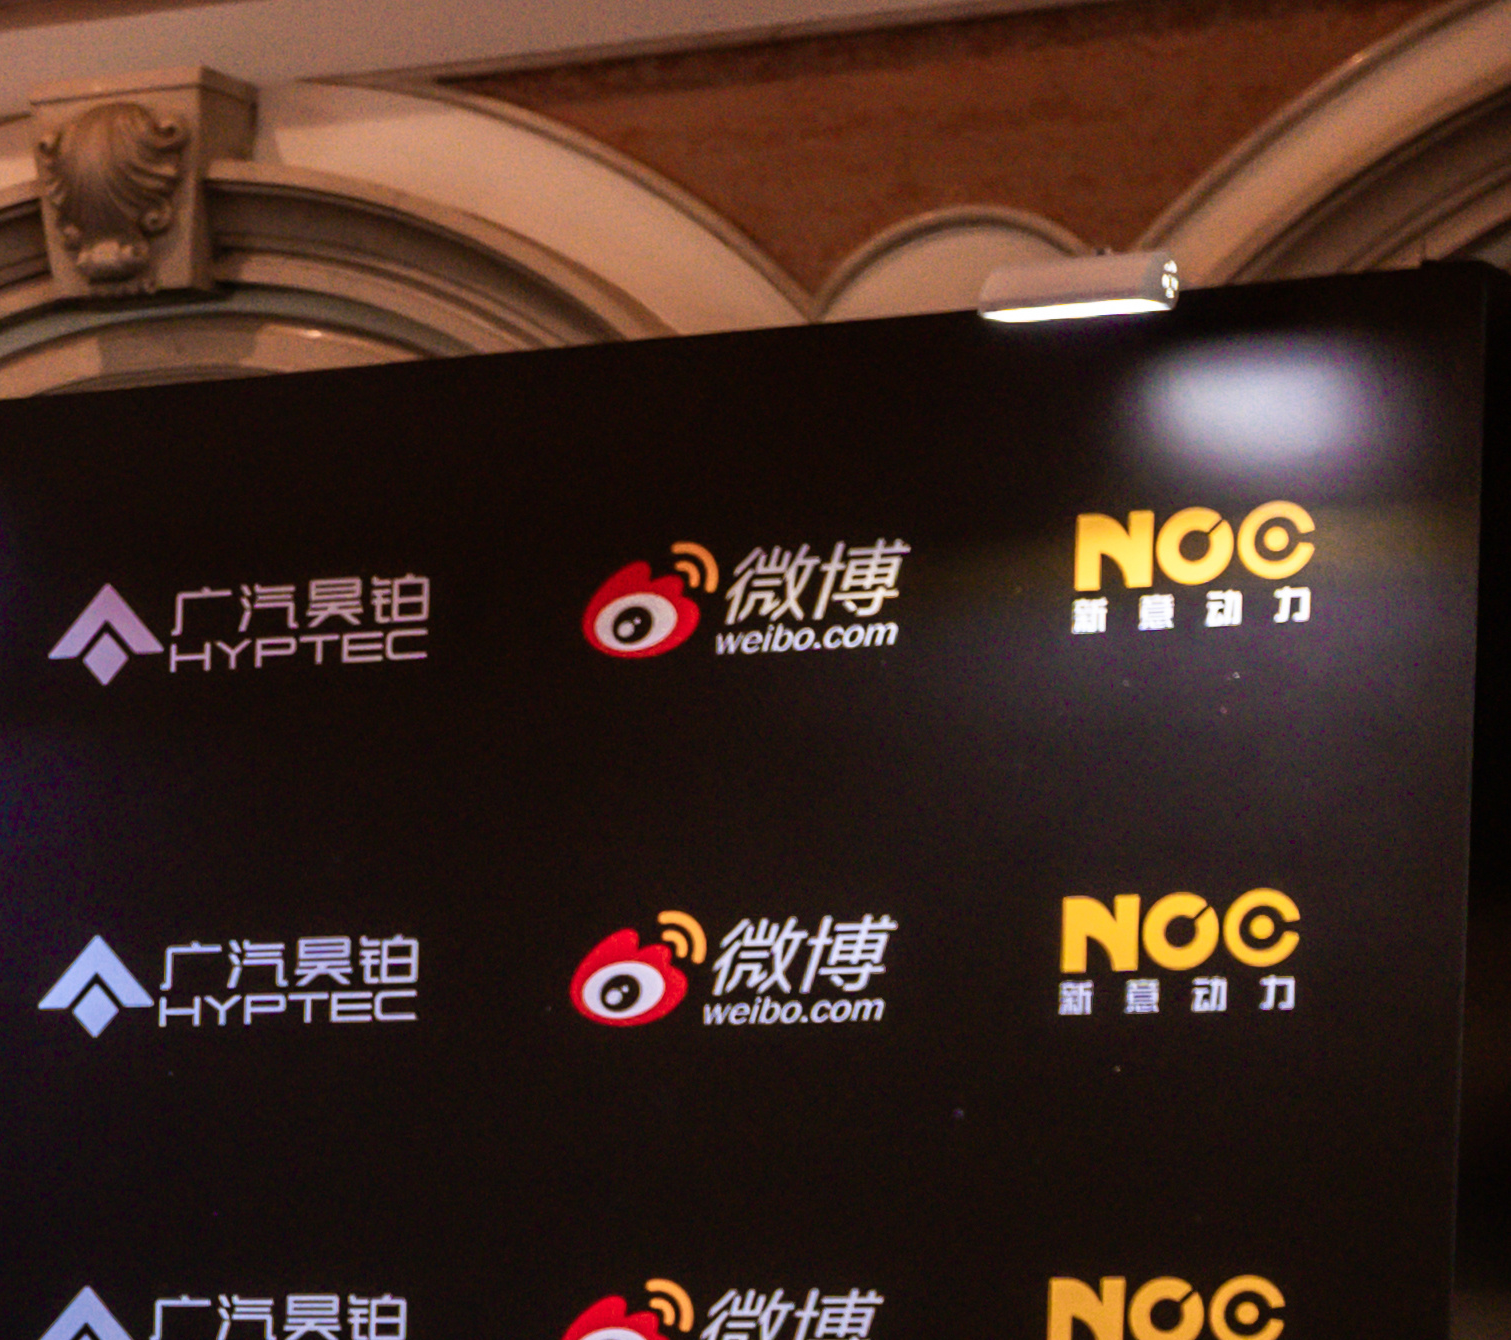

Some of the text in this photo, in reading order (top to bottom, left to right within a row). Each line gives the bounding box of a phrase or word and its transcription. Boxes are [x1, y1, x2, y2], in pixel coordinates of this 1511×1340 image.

[1073, 499, 1317, 592] NOC
[170, 573, 430, 637] 广汽昊铂
[725, 538, 911, 624] 微博
[716, 613, 900, 655] weibo.com
[1071, 585, 1312, 635] 新意动力
[169, 628, 428, 674] HYPTEC
[712, 913, 898, 995] 微博
[1060, 887, 1301, 974] NOC
[159, 934, 420, 991] 广汽昊铂
[158, 989, 418, 1028] HYPTEC
[703, 989, 886, 1026] weibo.com
[1058, 974, 1296, 1016] 新意动力
